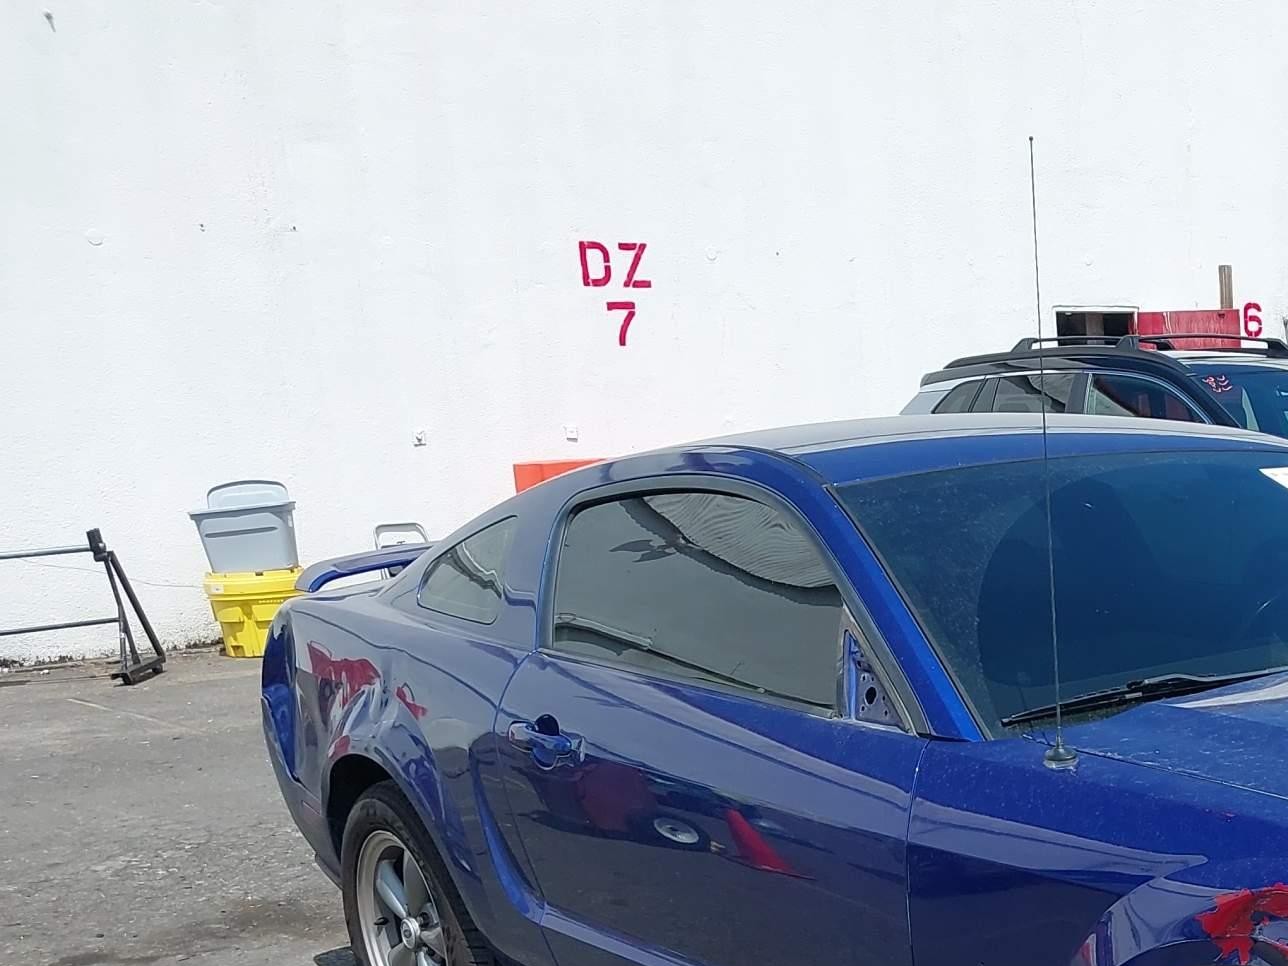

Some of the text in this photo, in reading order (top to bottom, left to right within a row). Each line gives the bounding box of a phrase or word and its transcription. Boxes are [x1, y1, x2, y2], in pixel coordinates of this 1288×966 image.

[578, 240, 653, 289] DZ
[606, 301, 636, 347] 7
[1243, 302, 1263, 338] 6
